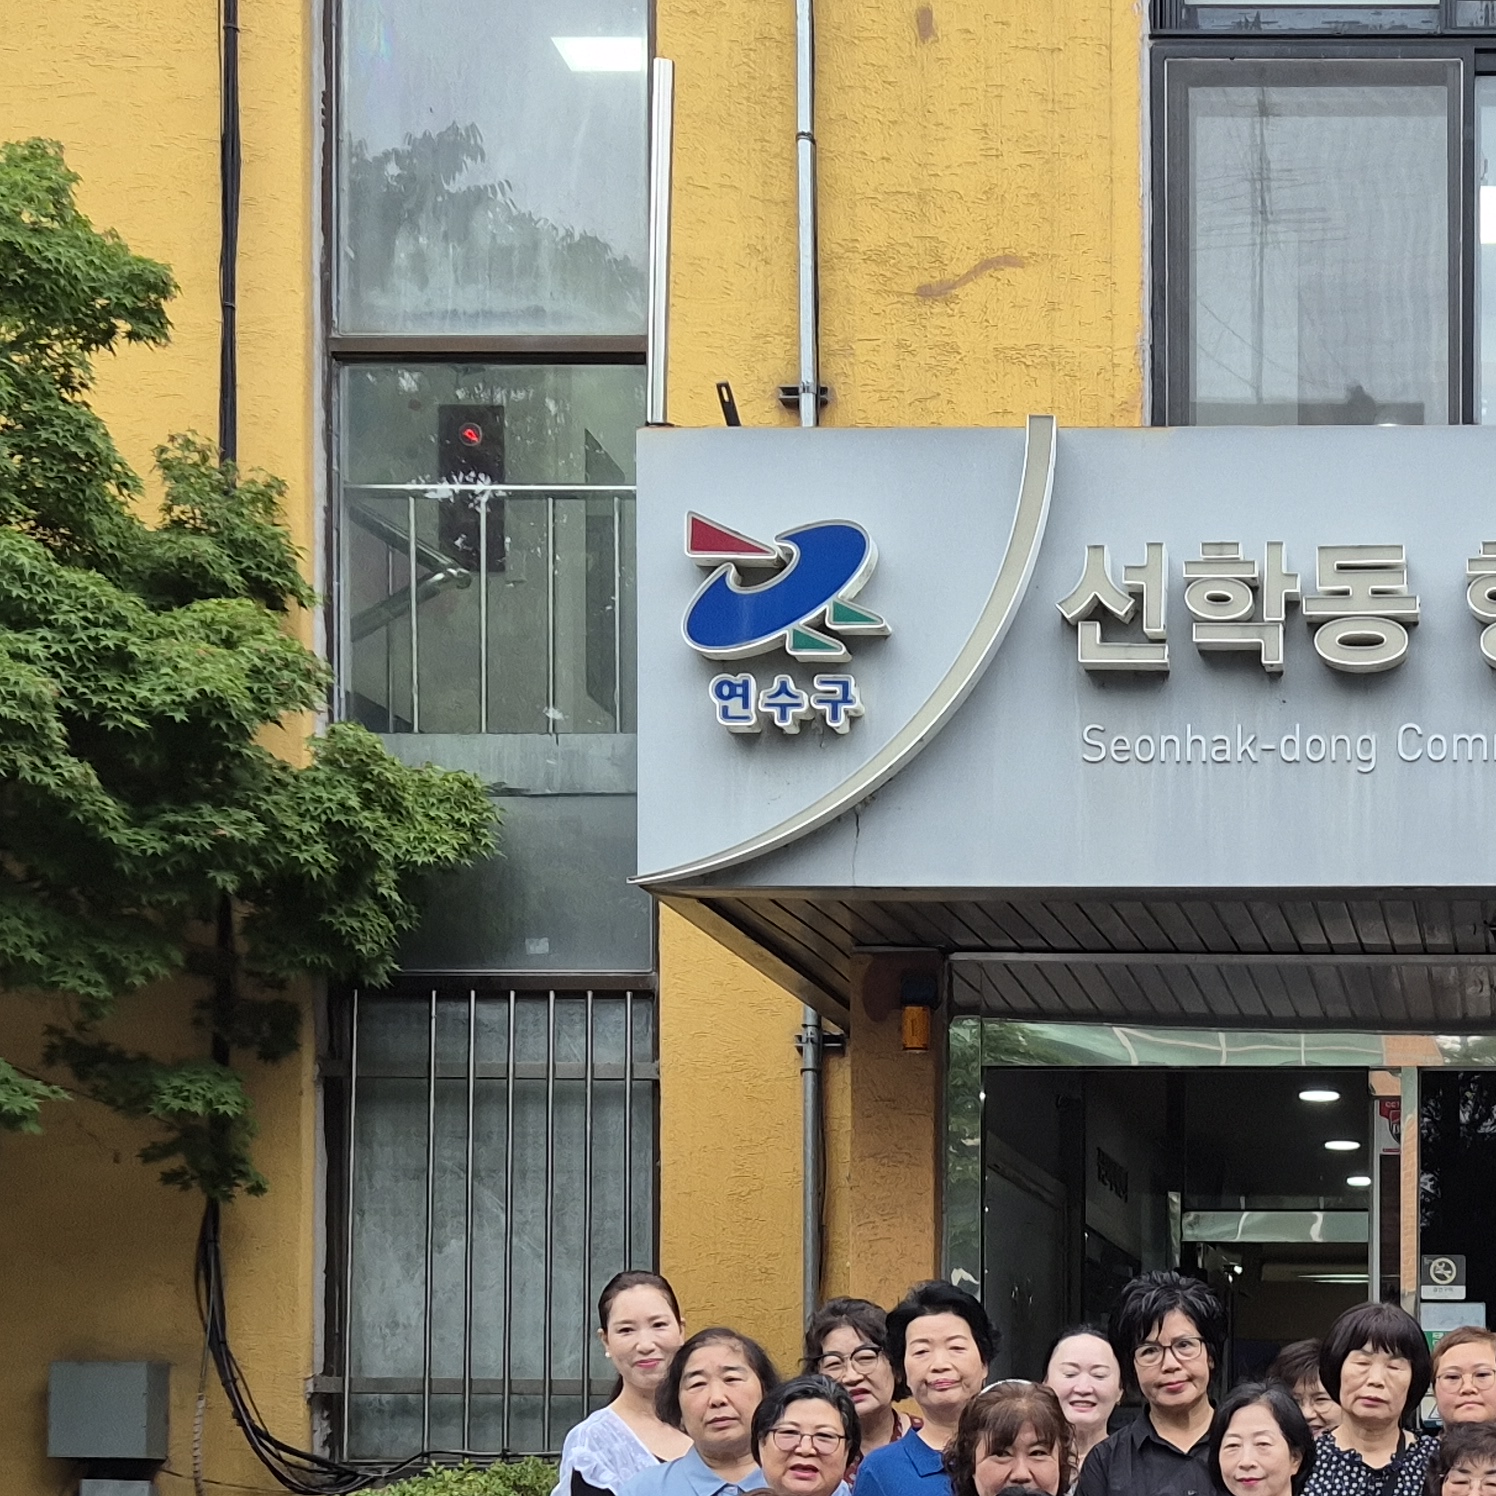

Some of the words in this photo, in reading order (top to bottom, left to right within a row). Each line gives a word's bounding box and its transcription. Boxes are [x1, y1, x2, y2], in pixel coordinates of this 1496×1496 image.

[1057, 541, 1420, 673] 선학동
[709, 672, 862, 731] 연수구
[1082, 723, 1378, 773] Seonhak-dong
